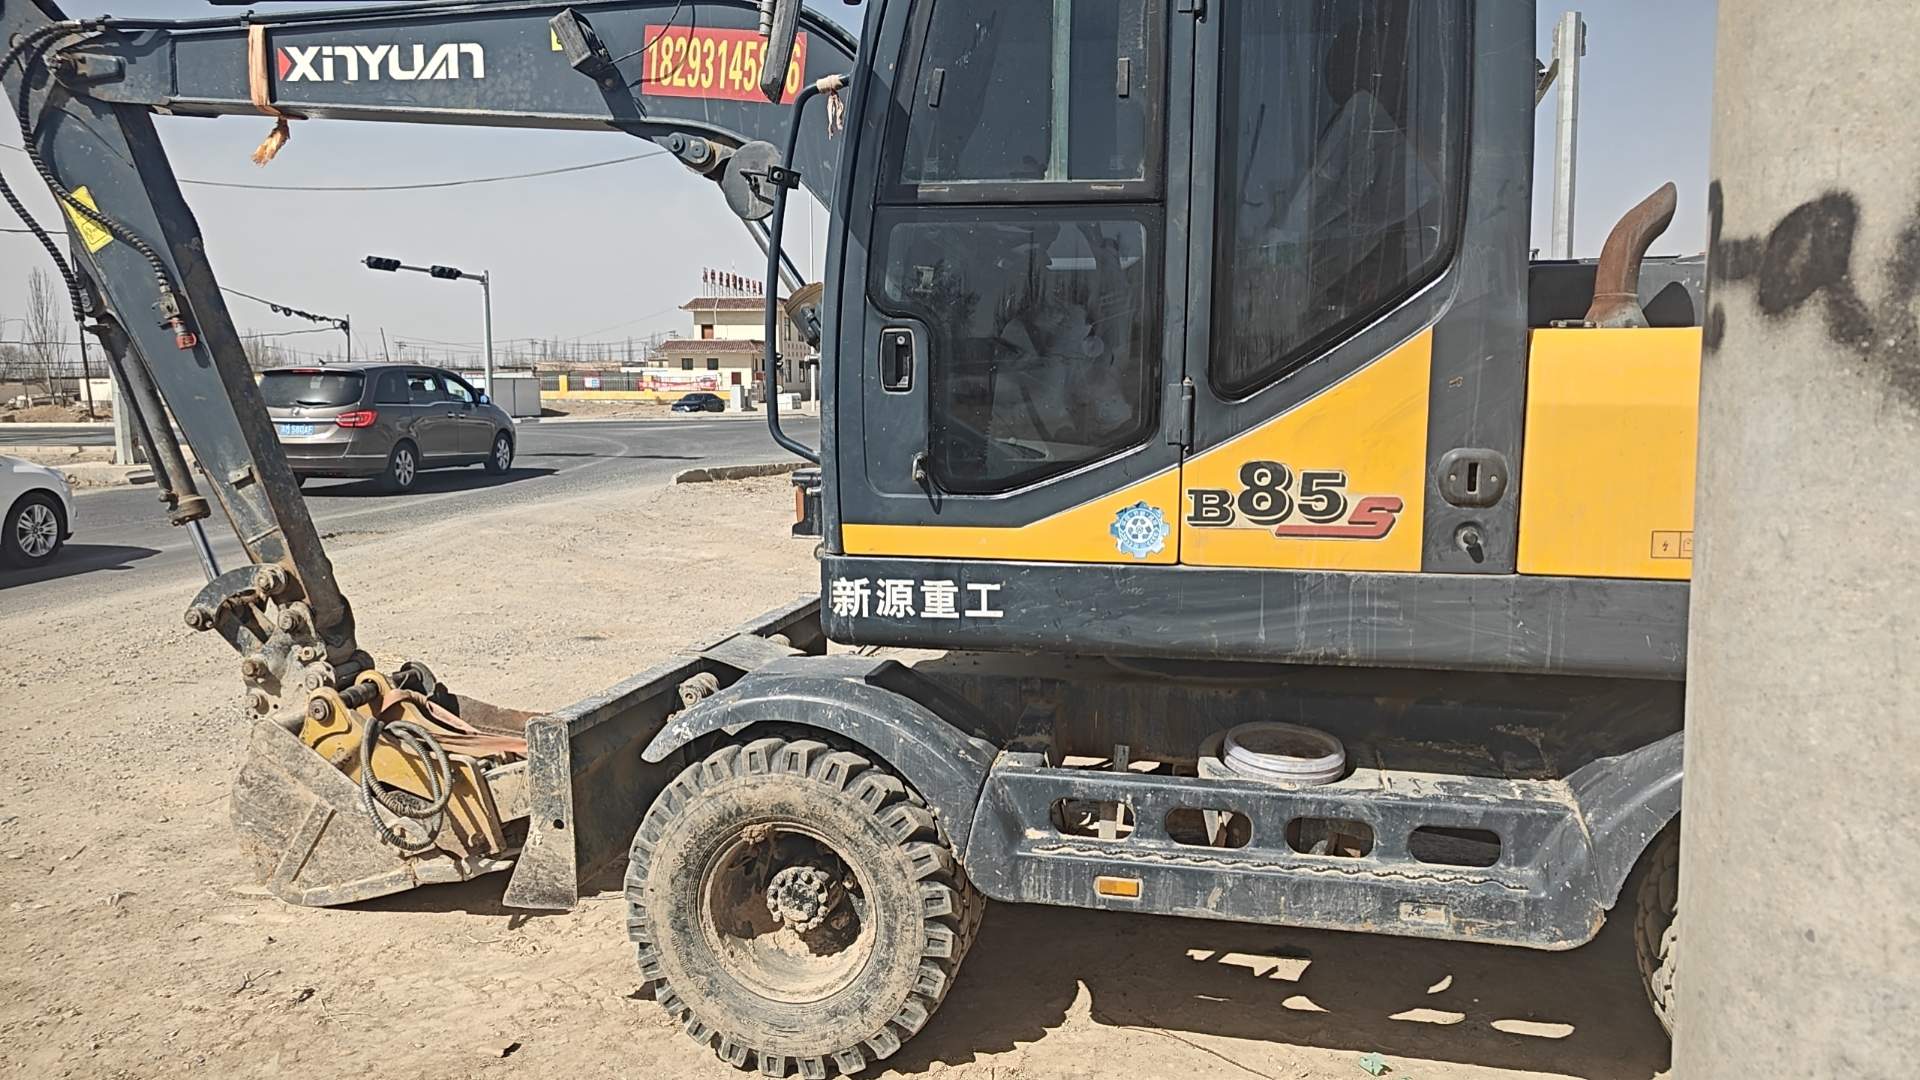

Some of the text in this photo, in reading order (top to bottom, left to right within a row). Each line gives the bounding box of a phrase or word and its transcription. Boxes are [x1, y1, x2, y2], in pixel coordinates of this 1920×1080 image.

[649, 35, 801, 95] 182931456
[832, 576, 1004, 619] 新源重工
